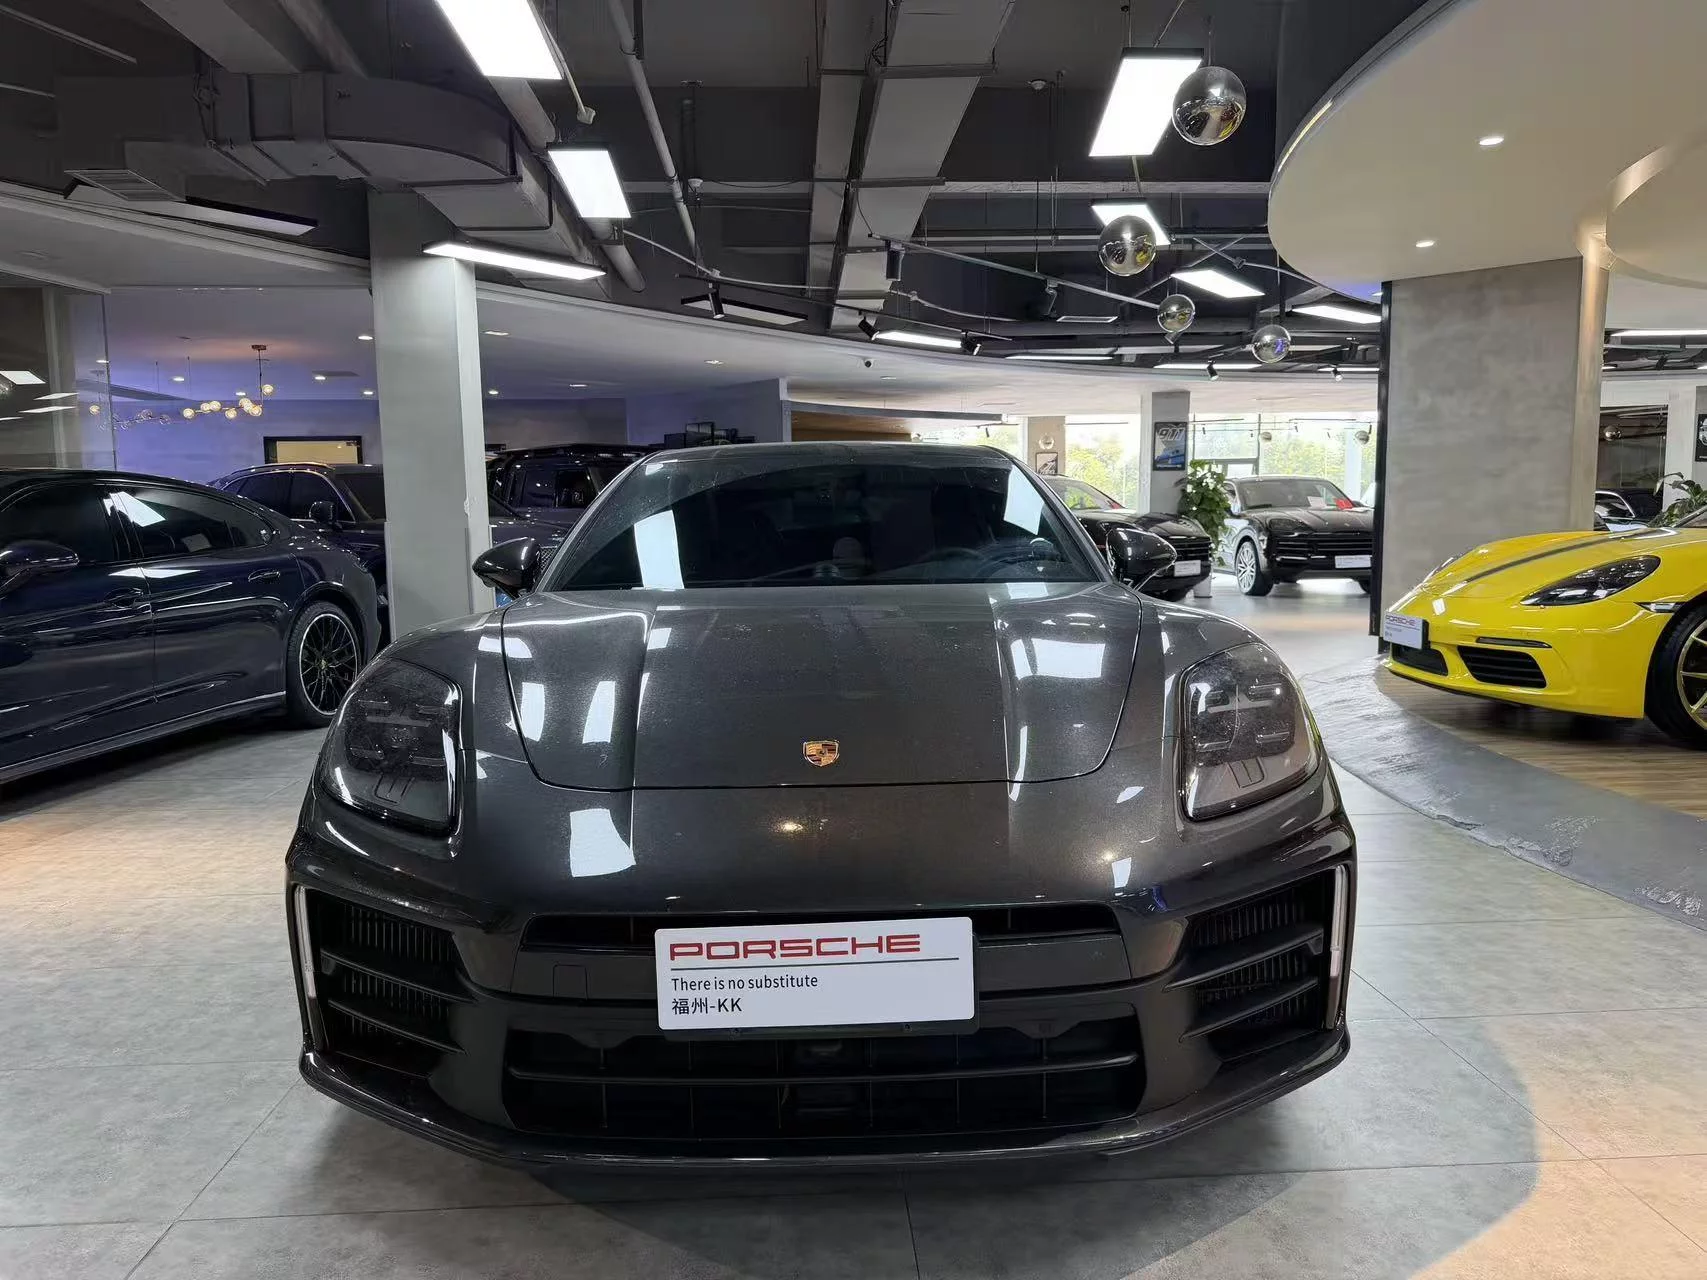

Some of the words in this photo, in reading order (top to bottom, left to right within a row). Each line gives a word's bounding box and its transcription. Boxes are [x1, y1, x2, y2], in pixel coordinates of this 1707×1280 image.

[1159, 428, 1185, 440] 911
[670, 934, 921, 961] PORSCHE
[671, 977, 711, 991] There
[714, 976, 725, 990] is
[728, 978, 745, 990] no
[748, 974, 818, 989] substitute
[671, 997, 742, 1015] 福州-KK
